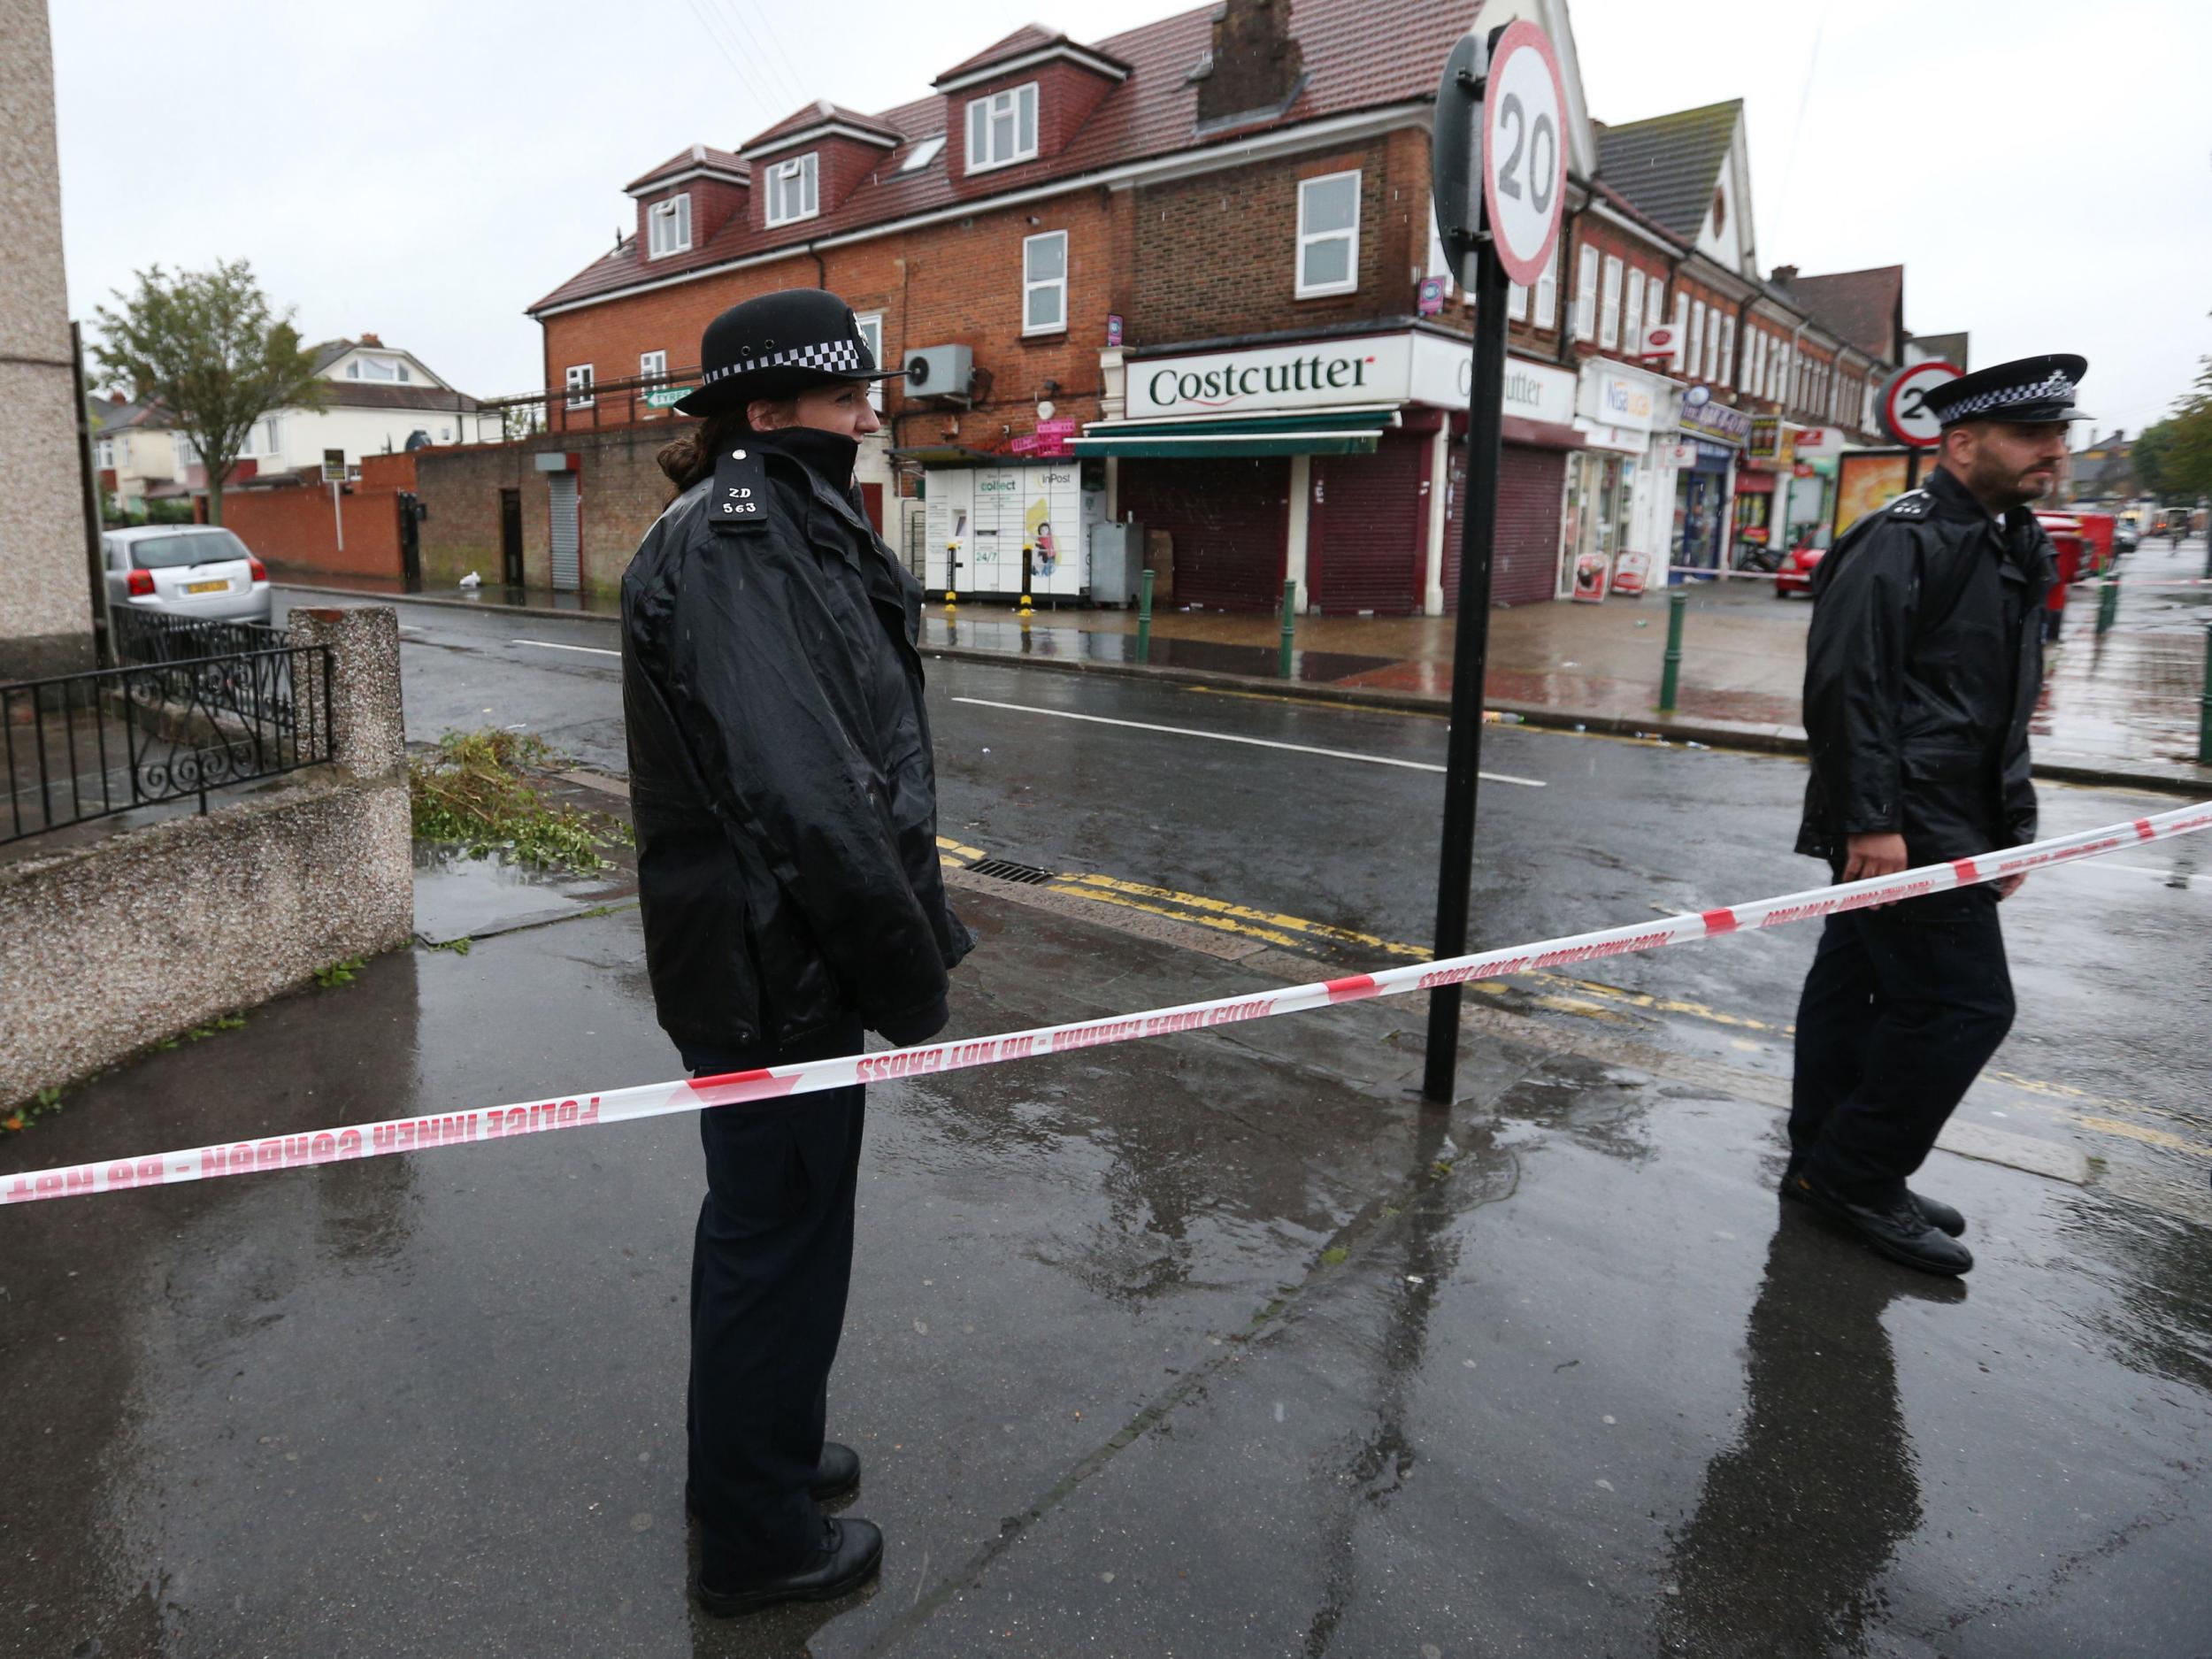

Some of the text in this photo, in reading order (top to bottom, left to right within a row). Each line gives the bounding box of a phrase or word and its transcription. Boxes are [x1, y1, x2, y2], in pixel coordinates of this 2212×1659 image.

[1499, 92, 1555, 214] 20
[1149, 355, 1376, 406] Costcutter
[1458, 358, 1543, 406] Cutter
[1901, 388, 1924, 419] 2
[981, 481, 1016, 491] collect
[723, 503, 757, 513] 563
[976, 552, 997, 563] 24/7
[856, 1049, 943, 1083] CROSS
[946, 1045, 995, 1068] NOT
[488, 1096, 601, 1136] POLICE
[373, 1117, 478, 1153] INNER
[202, 1129, 363, 1177] CORDON
[6, 1168, 94, 1203] NOT
